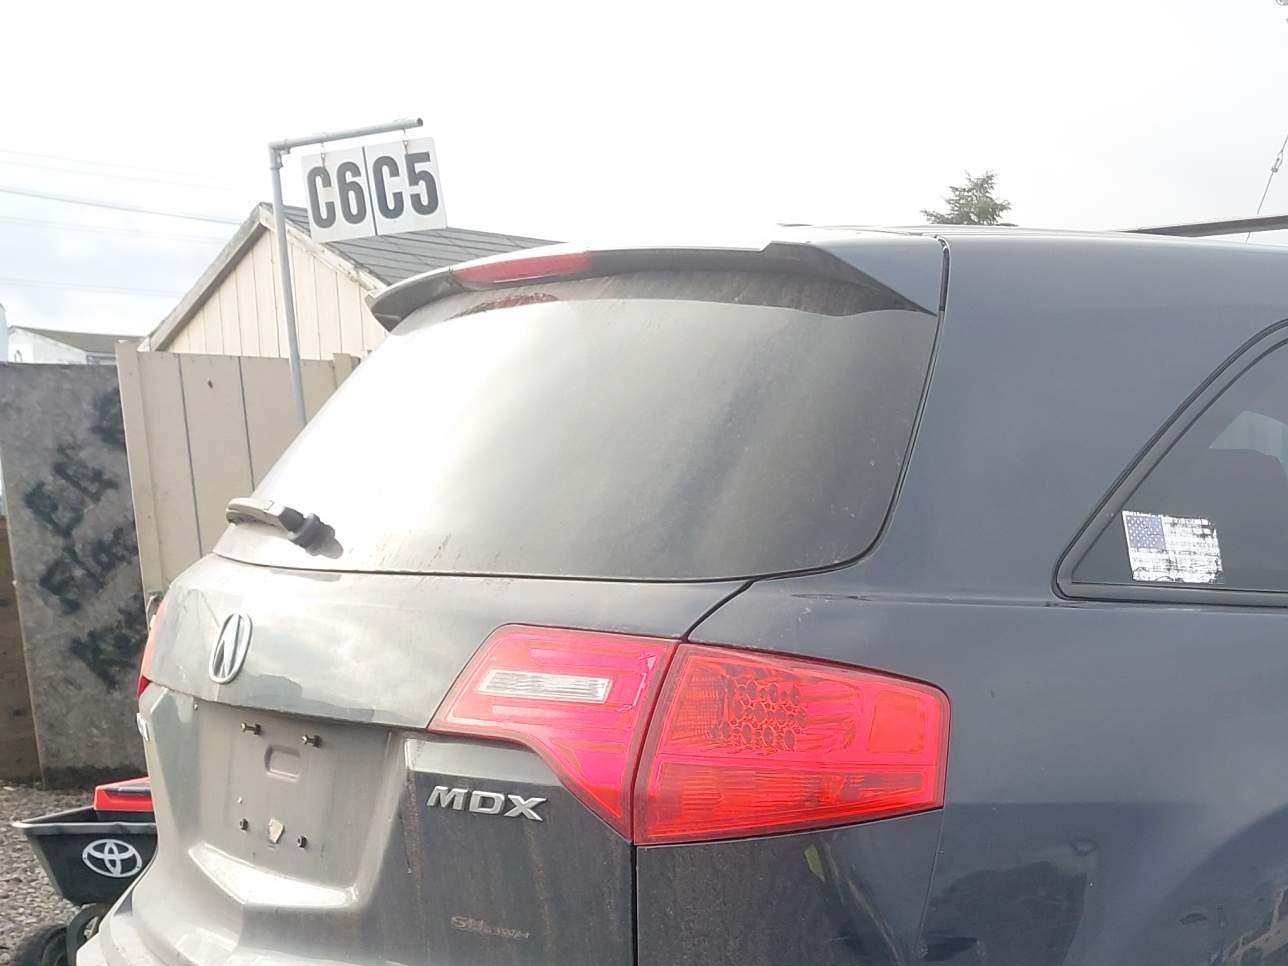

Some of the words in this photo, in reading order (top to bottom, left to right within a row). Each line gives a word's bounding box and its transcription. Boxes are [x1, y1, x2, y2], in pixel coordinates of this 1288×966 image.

[306, 161, 367, 229] C6
[372, 151, 439, 220] C5
[426, 785, 547, 822] MDX
